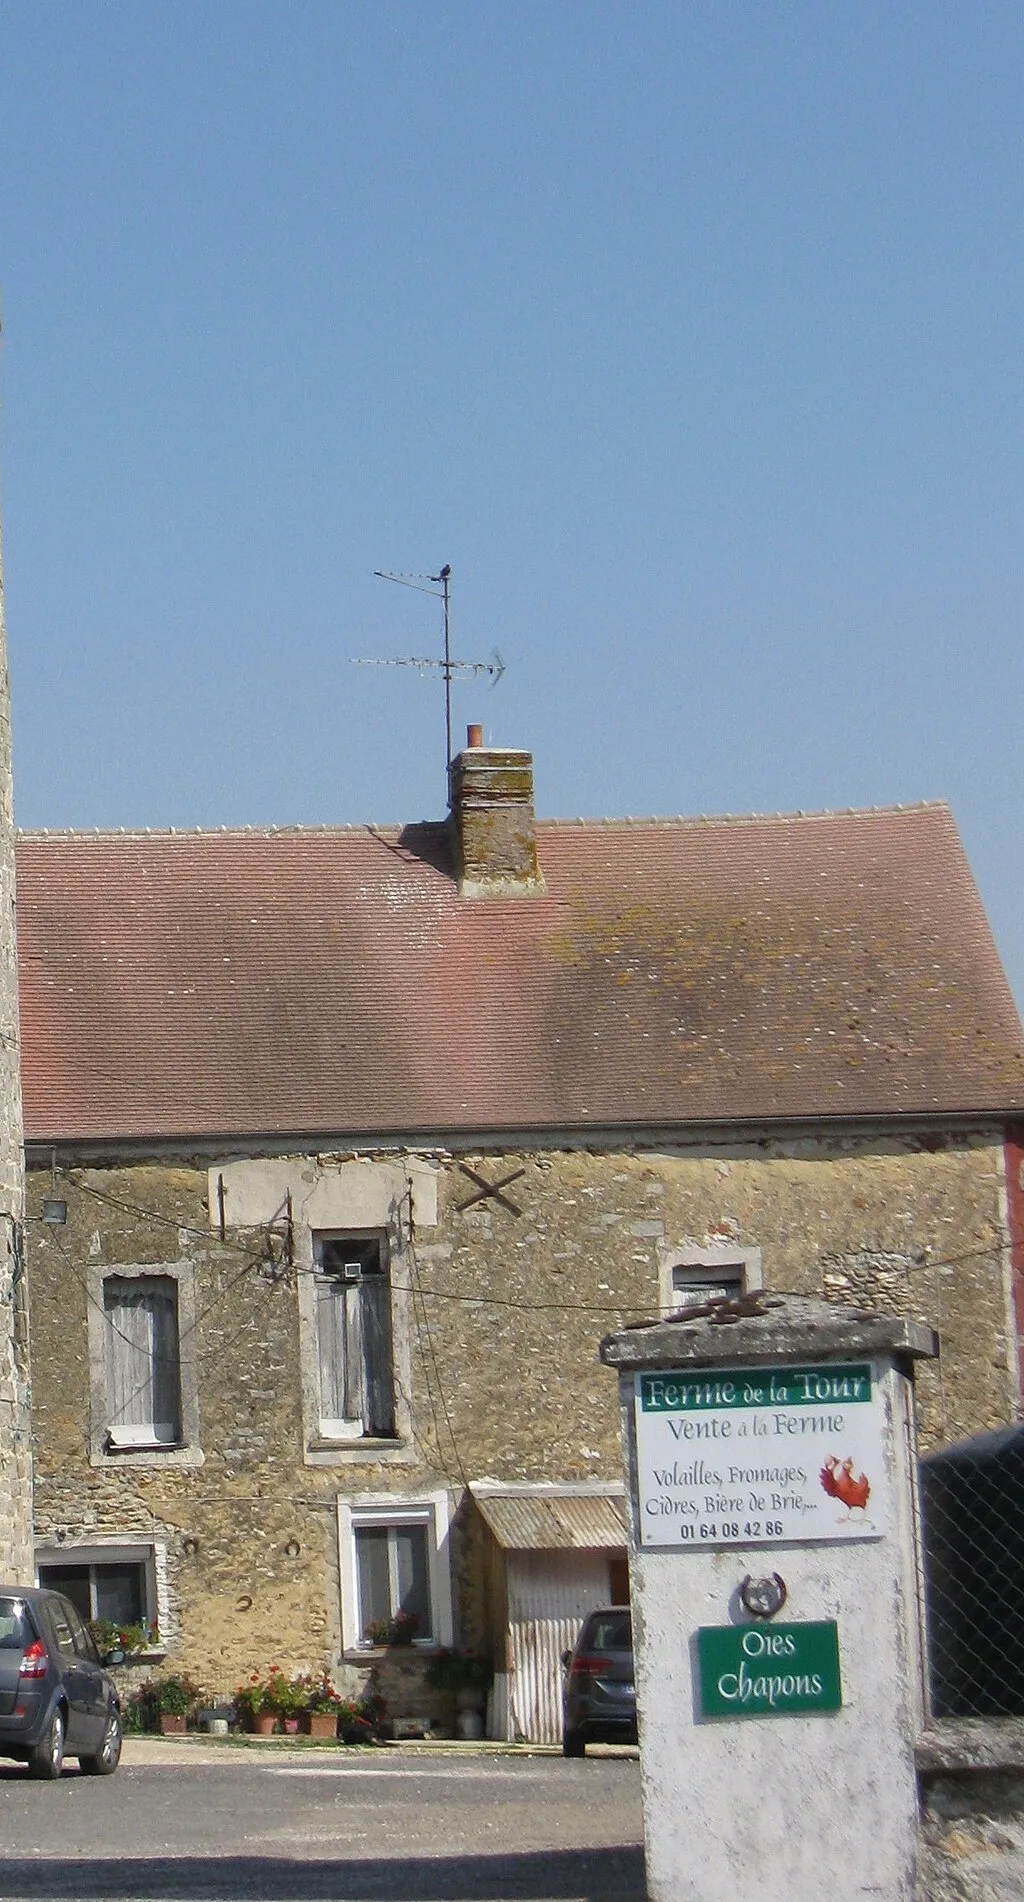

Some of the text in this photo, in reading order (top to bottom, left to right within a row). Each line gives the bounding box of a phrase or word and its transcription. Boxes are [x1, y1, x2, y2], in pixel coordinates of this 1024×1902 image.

[646, 1372, 866, 1407] Ferme de la Tour
[666, 1412, 845, 1440] Vente à la Ferme
[652, 1460, 807, 1488] Volailles, Fromages,
[645, 1495, 699, 1519] Cidres,
[704, 1493, 743, 1513] Bière
[748, 1491, 764, 1511] de
[680, 1520, 783, 1539] 01 64 08 42 86
[742, 1631, 795, 1657] Oies
